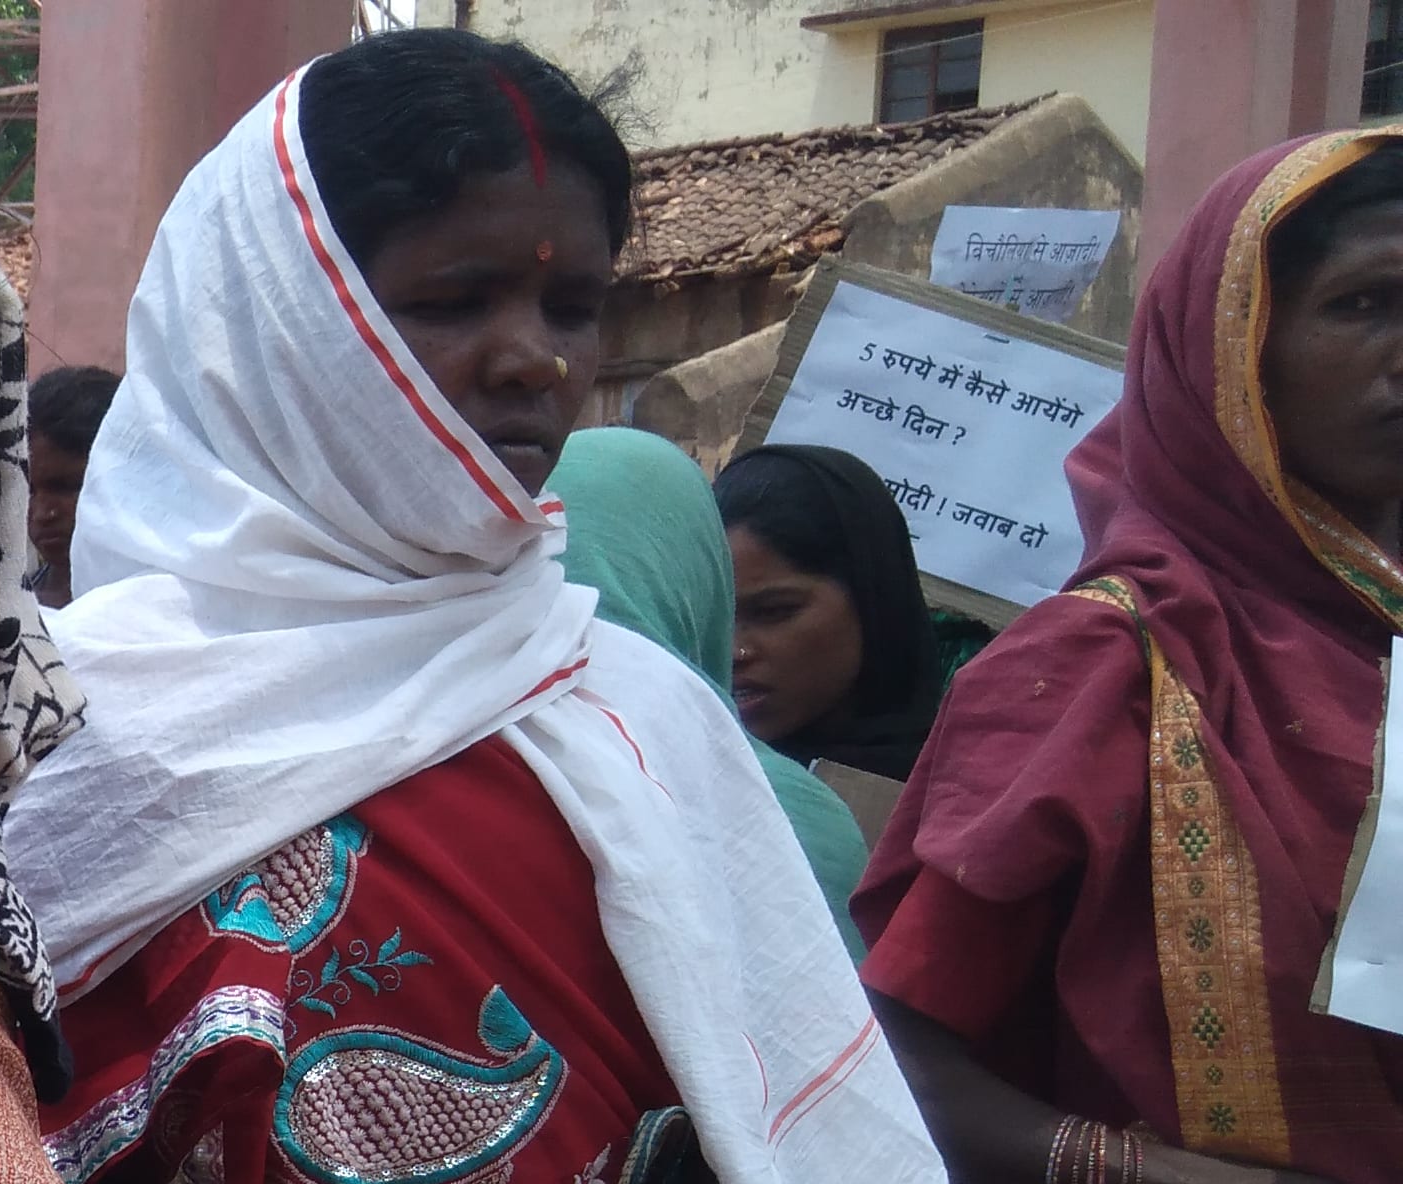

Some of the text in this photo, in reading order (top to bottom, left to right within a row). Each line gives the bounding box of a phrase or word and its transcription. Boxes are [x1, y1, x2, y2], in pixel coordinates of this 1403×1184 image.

[859, 343, 1084, 428] 5 रुपये में कैसे आयेंगे
[836, 388, 966, 445] अच्छे दिन ?
[936, 497, 947, 516] !
[952, 501, 1017, 538] जवाब
[1019, 523, 1048, 548] दो
